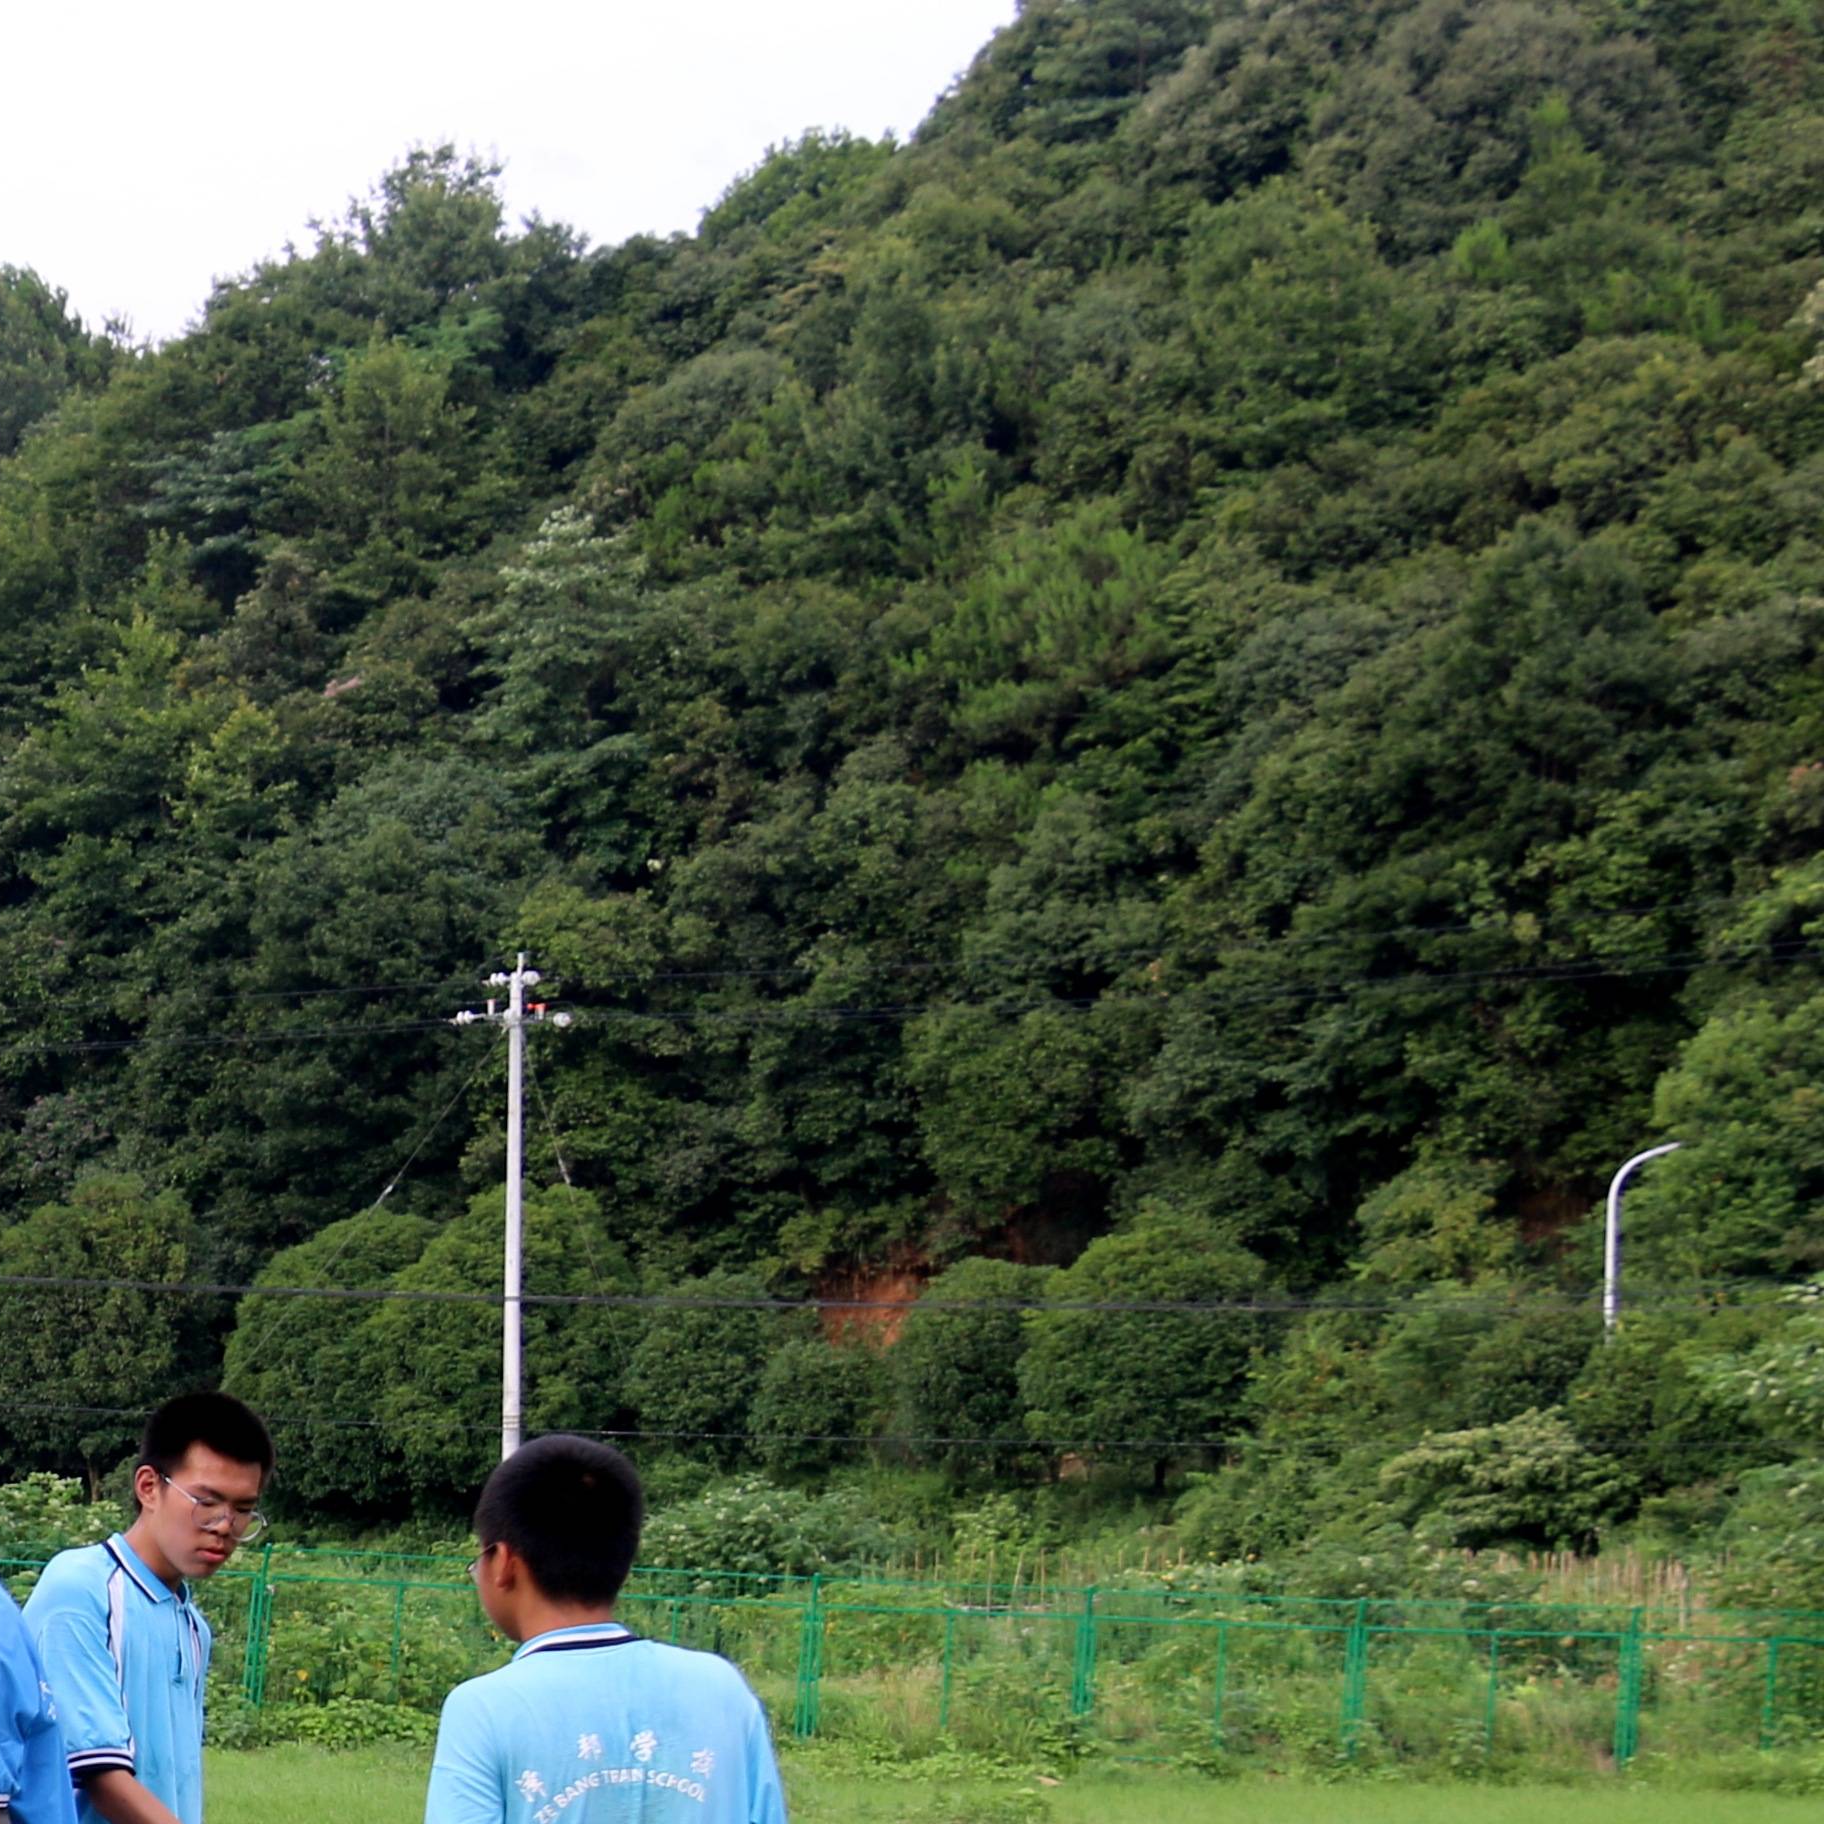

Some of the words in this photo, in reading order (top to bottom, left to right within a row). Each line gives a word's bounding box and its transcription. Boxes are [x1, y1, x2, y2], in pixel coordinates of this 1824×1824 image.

[553, 1771, 600, 1809] BANG
[601, 1767, 644, 1784] TRAIN
[646, 1769, 706, 1803] SCHOOL
